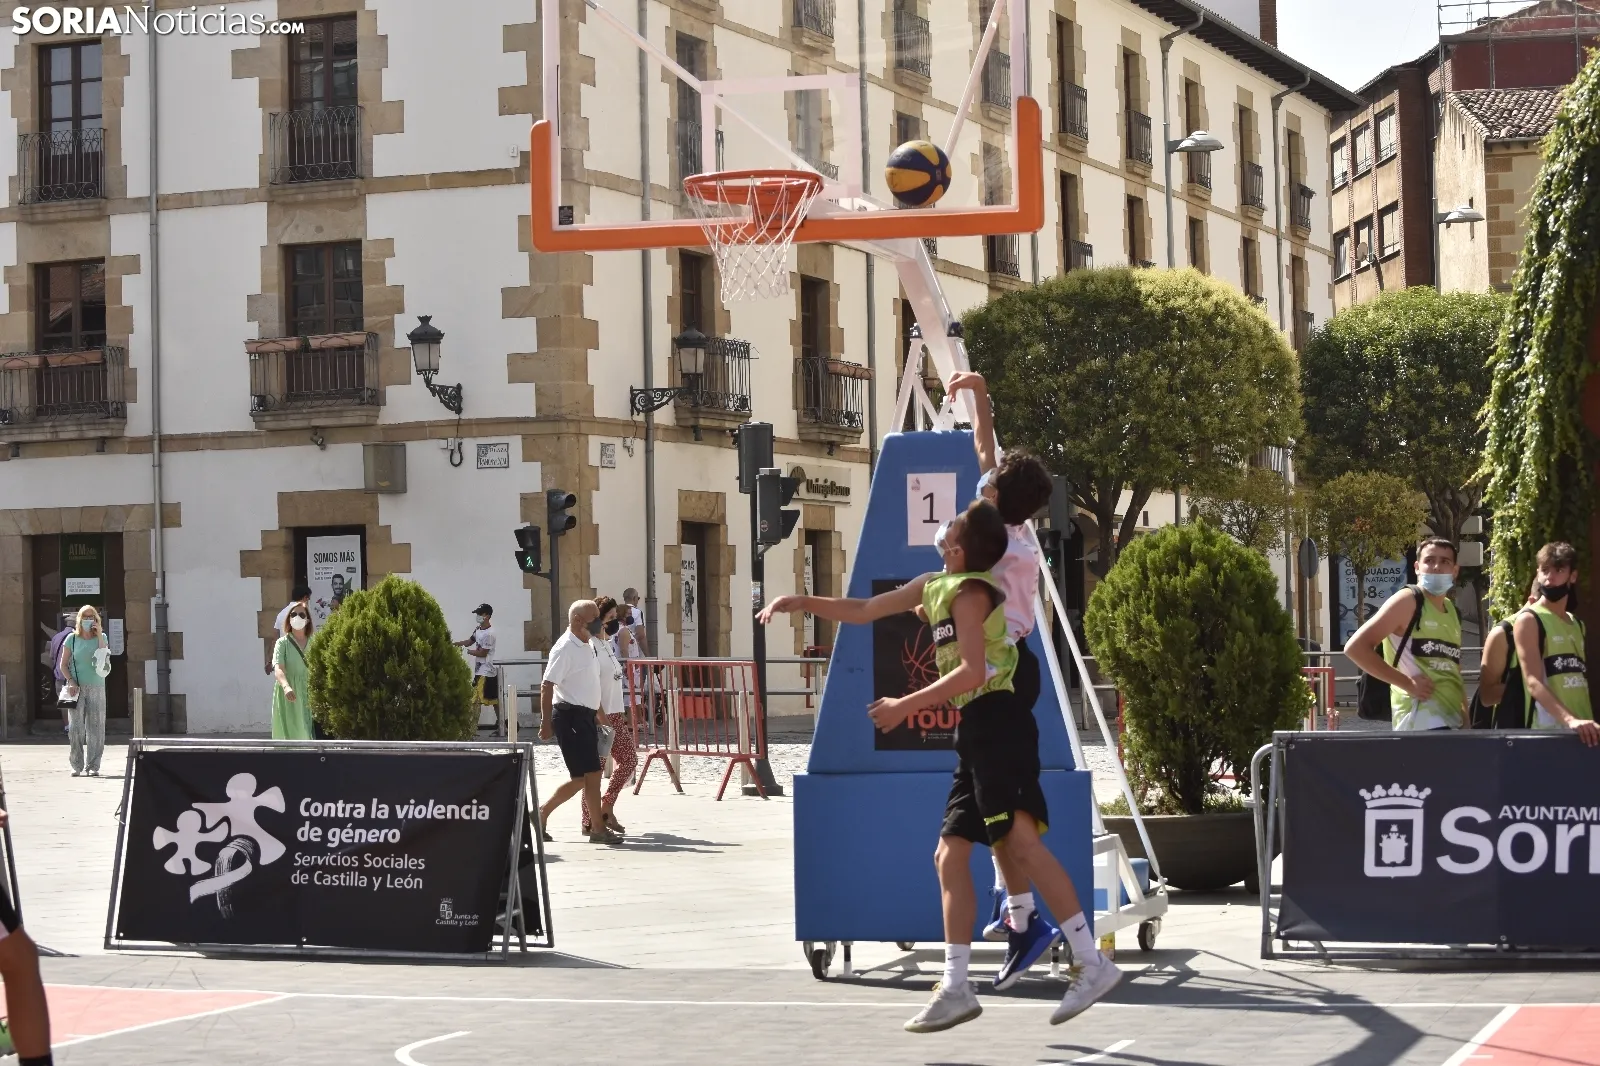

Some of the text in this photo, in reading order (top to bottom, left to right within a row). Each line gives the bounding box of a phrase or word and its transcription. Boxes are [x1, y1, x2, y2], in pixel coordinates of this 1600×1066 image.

[922, 492, 940, 524] 1
[69, 543, 86, 556] ATM
[313, 549, 355, 563] SOMOS MÁS
[1345, 567, 1401, 576] GRDUADAS
[299, 797, 490, 820] Contra la violencia
[1498, 805, 1600, 821] AYUNTAM
[296, 820, 401, 848] de género
[293, 852, 426, 870] Servicios Sociales
[290, 870, 423, 891] de Castilla y León
